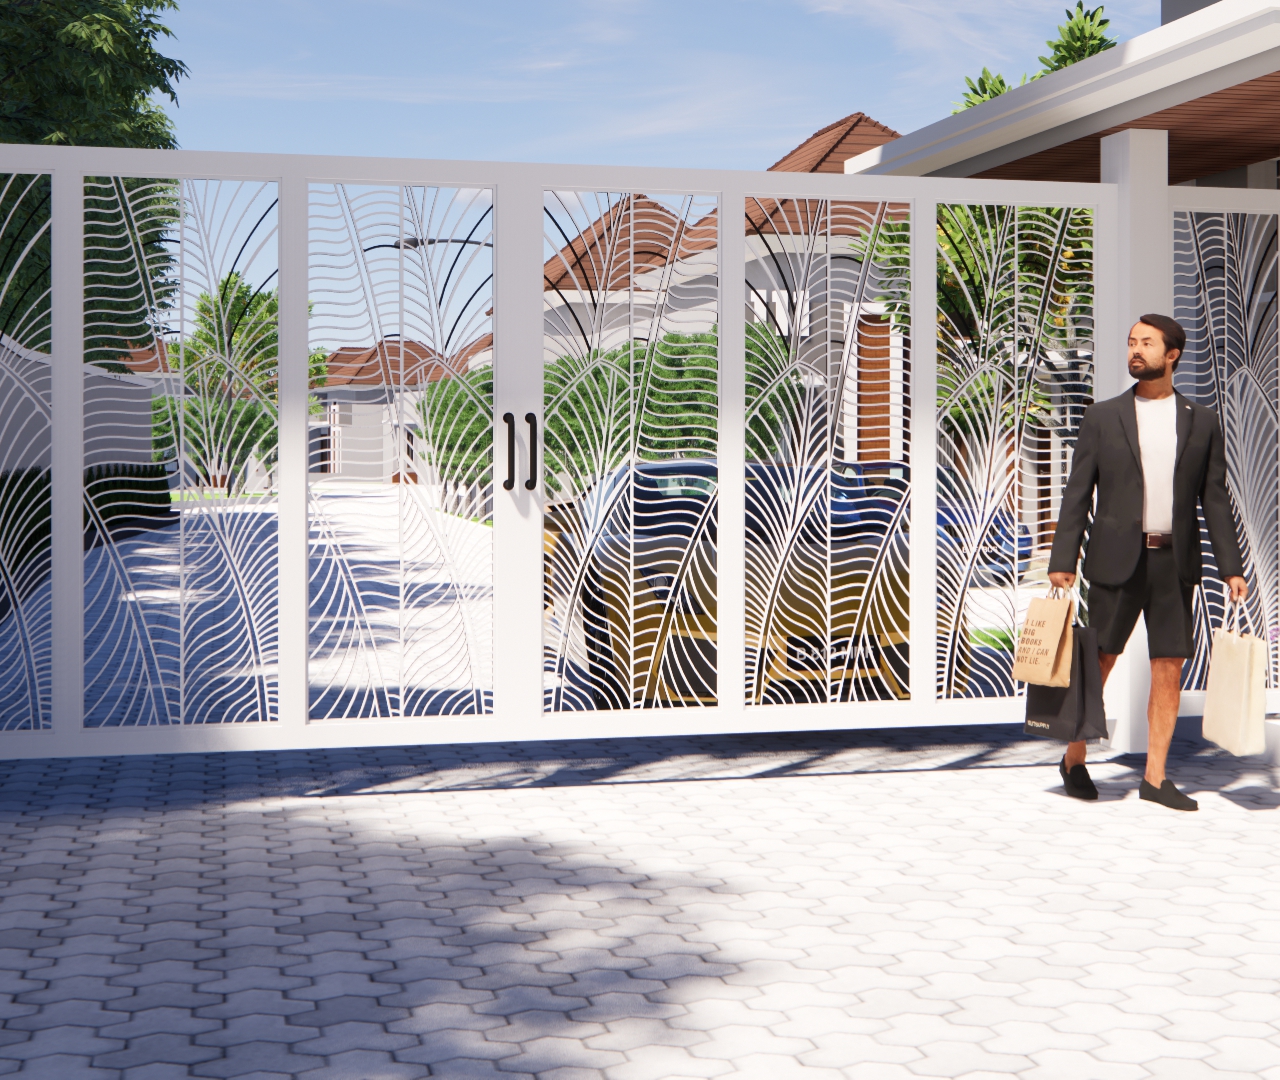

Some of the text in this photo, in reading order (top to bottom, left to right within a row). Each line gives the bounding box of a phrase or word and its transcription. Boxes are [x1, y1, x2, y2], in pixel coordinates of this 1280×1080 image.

[1030, 620, 1046, 628] LIKE
[1024, 628, 1036, 636] BIG
[1021, 637, 1042, 646] BOOKS
[796, 646, 807, 661] B
[1036, 648, 1050, 656] CAN
